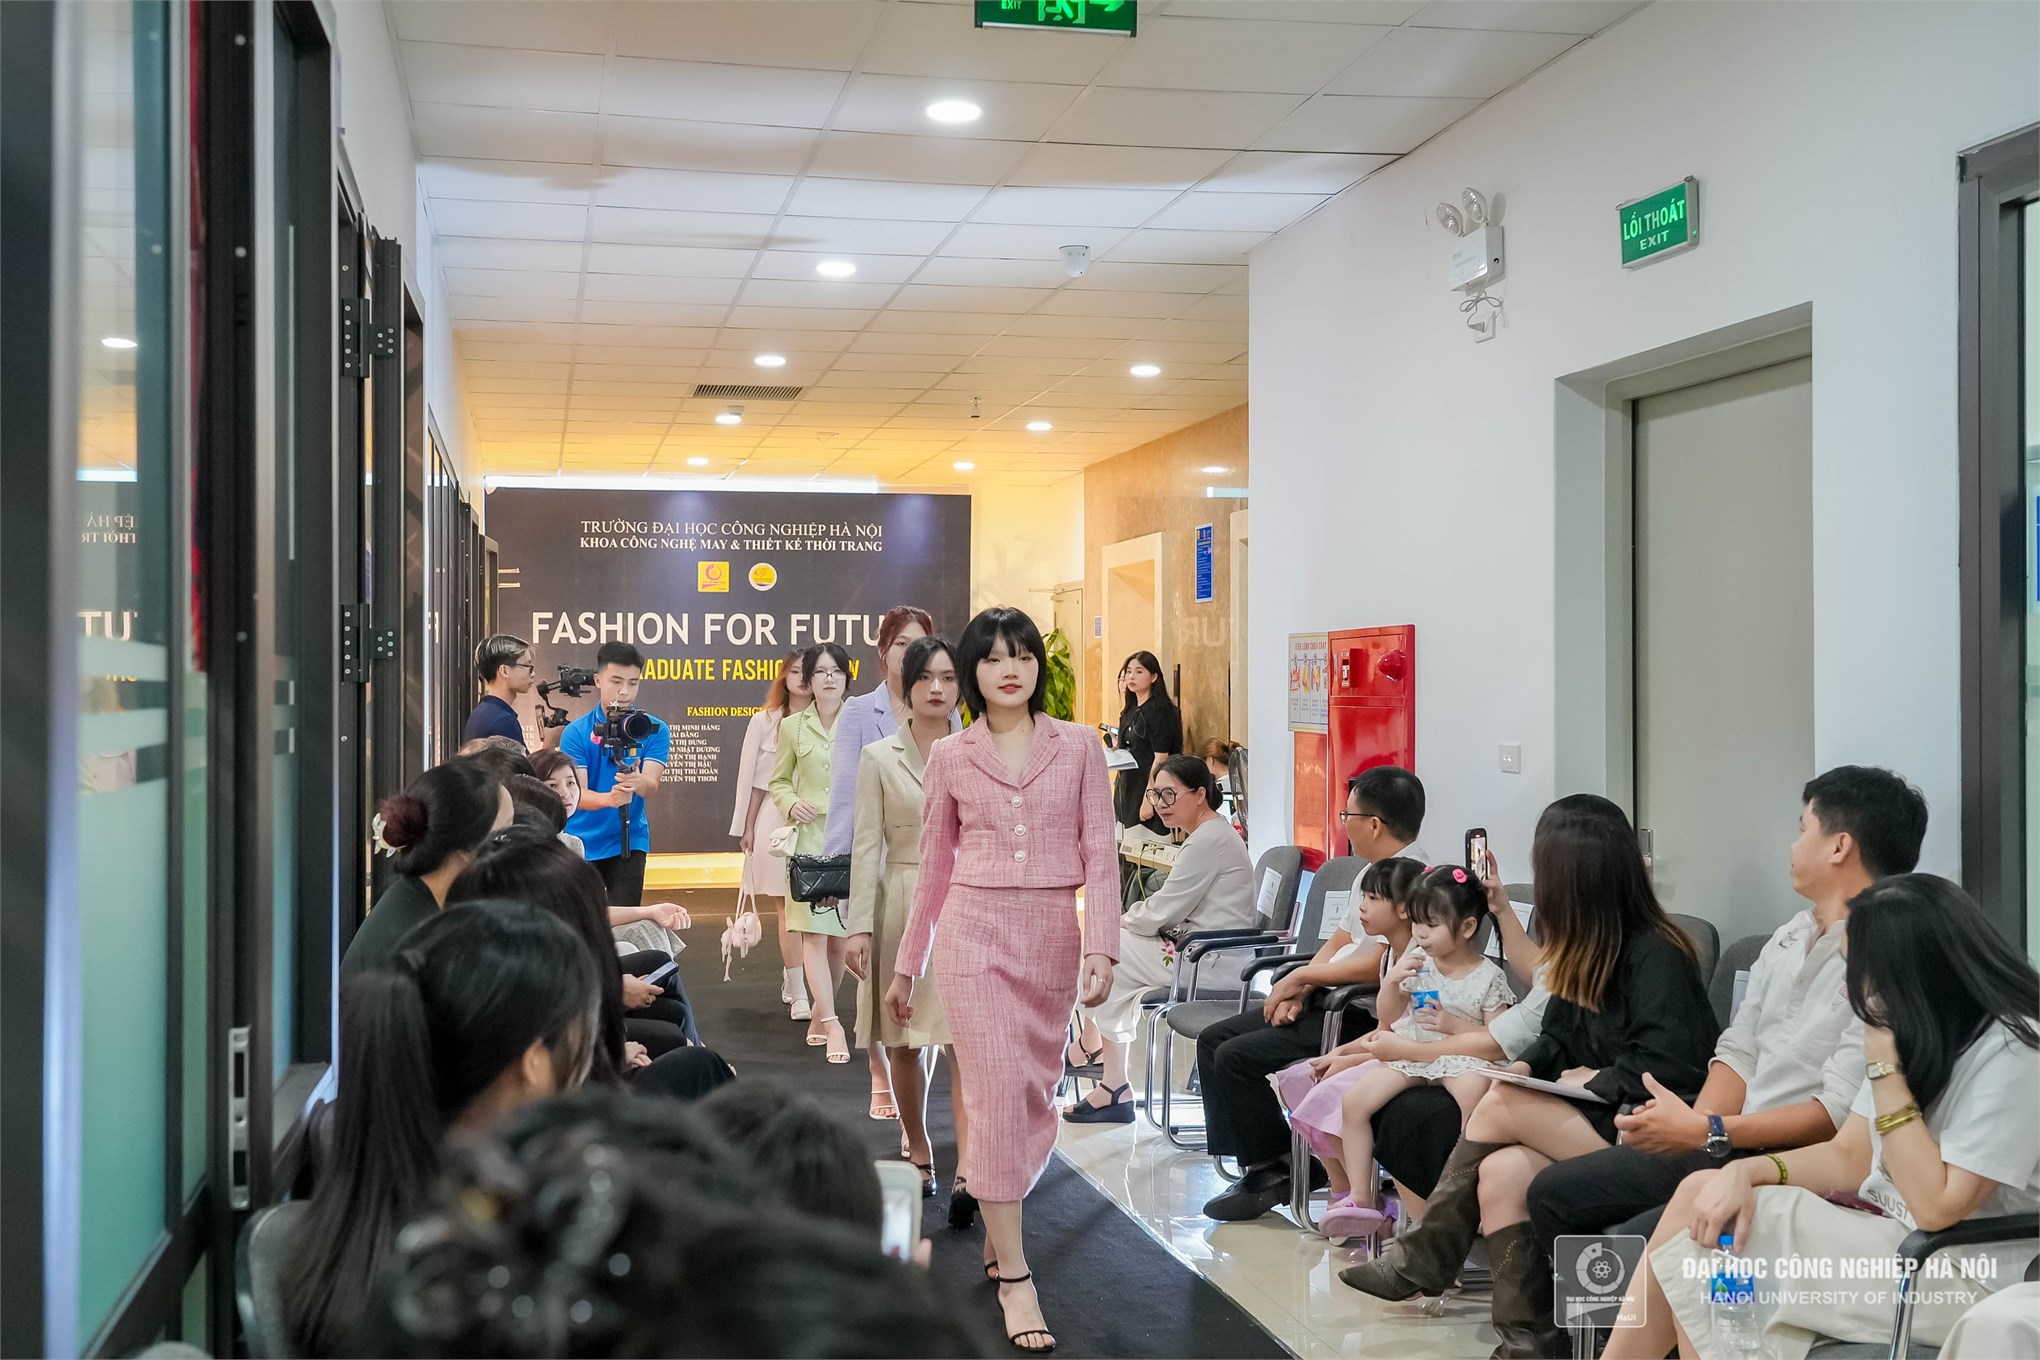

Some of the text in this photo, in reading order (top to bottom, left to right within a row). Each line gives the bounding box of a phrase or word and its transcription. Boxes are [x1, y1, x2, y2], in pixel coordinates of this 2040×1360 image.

[1001, 0, 1022, 10] EXIT
[1623, 198, 1686, 241] LỐI THOÁT
[1640, 230, 1670, 251] EXIT
[581, 518, 883, 539] TRƯỜNG ĐẠI HỌC CÔNG NGHIỆP HÀ NỘI
[580, 537, 618, 549] KHOA
[620, 535, 658, 549] CÔNG
[661, 537, 697, 551] NGHỆ
[701, 539, 728, 550] MAY
[730, 539, 740, 550] &
[805, 537, 836, 551] THỜI
[839, 541, 883, 552] TRANG
[532, 611, 886, 647] FASHION FOR FUTU
[687, 706, 762, 717] FASHION DESIG
